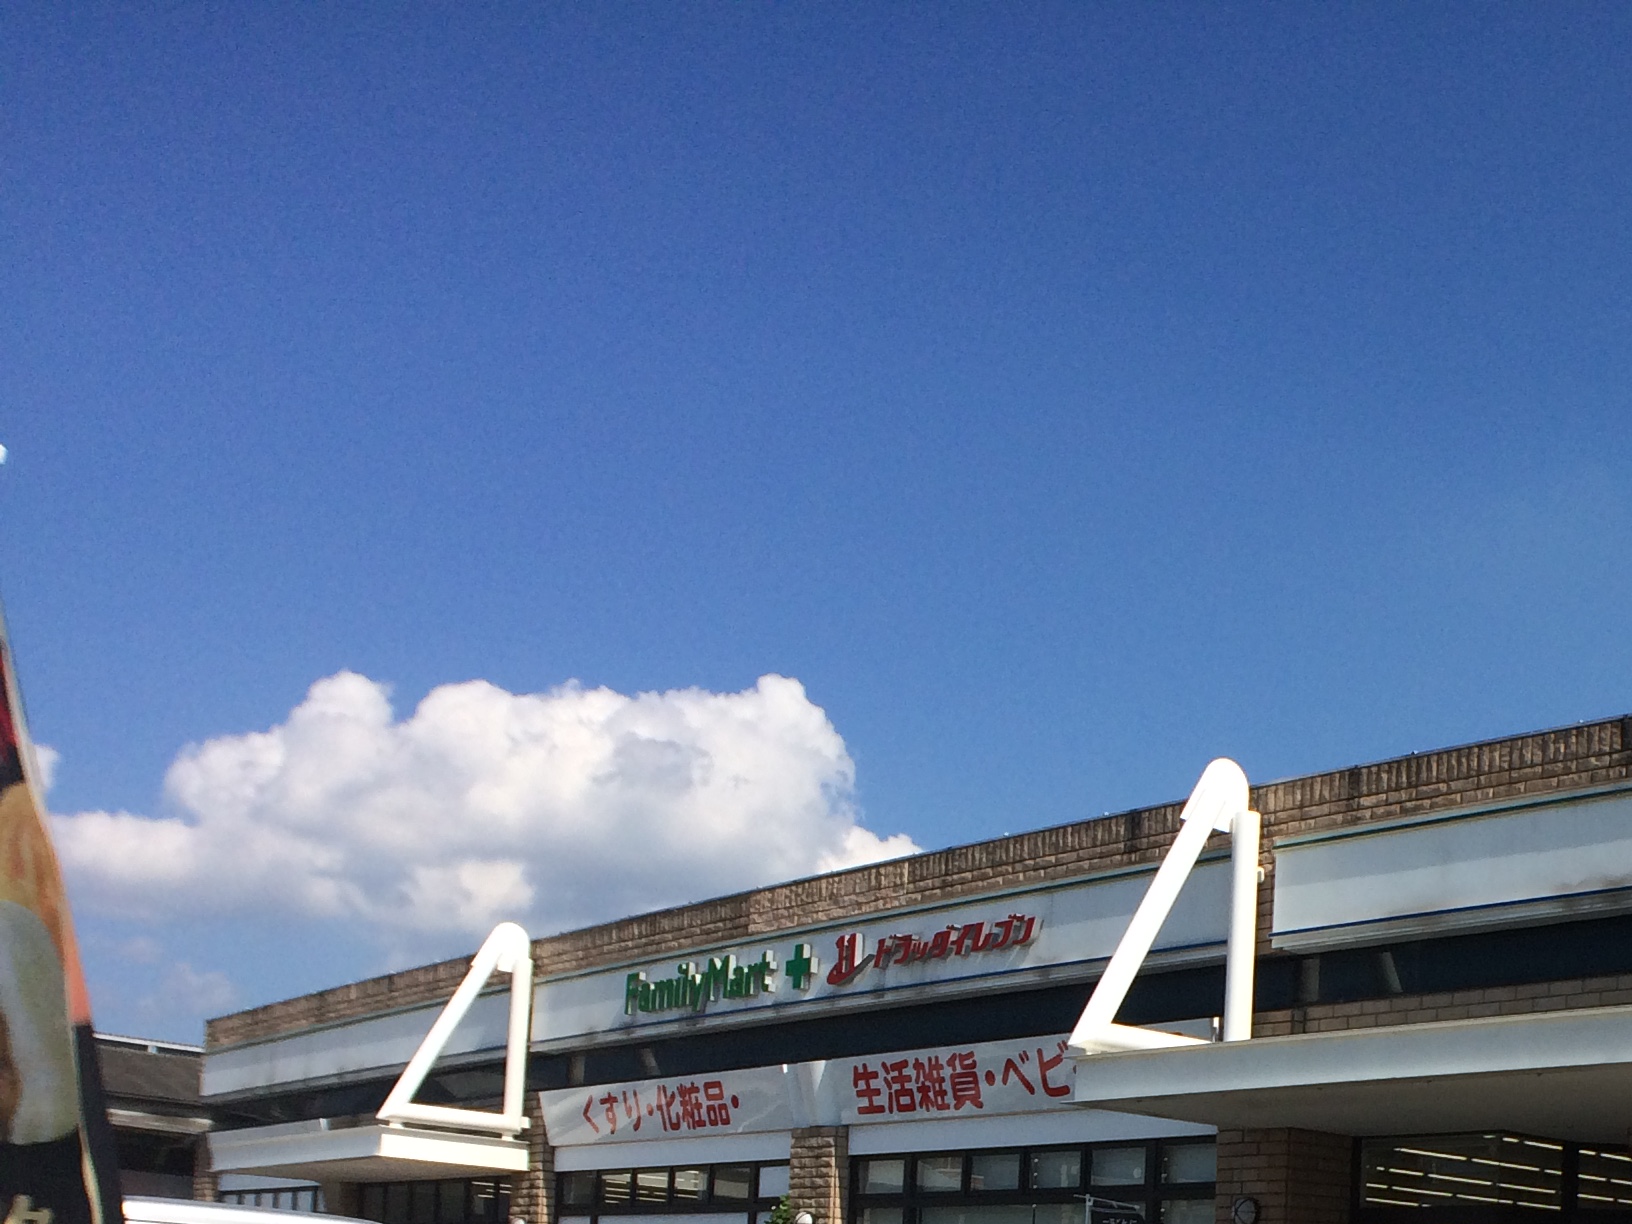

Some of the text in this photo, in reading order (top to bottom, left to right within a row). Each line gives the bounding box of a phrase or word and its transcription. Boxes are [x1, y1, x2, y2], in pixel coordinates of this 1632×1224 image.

[624, 949, 774, 1015] FamilyMart
[872, 914, 1038, 969] ドラッグイレブン
[852, 1039, 1077, 1115] 生活雑貨・ベビ
